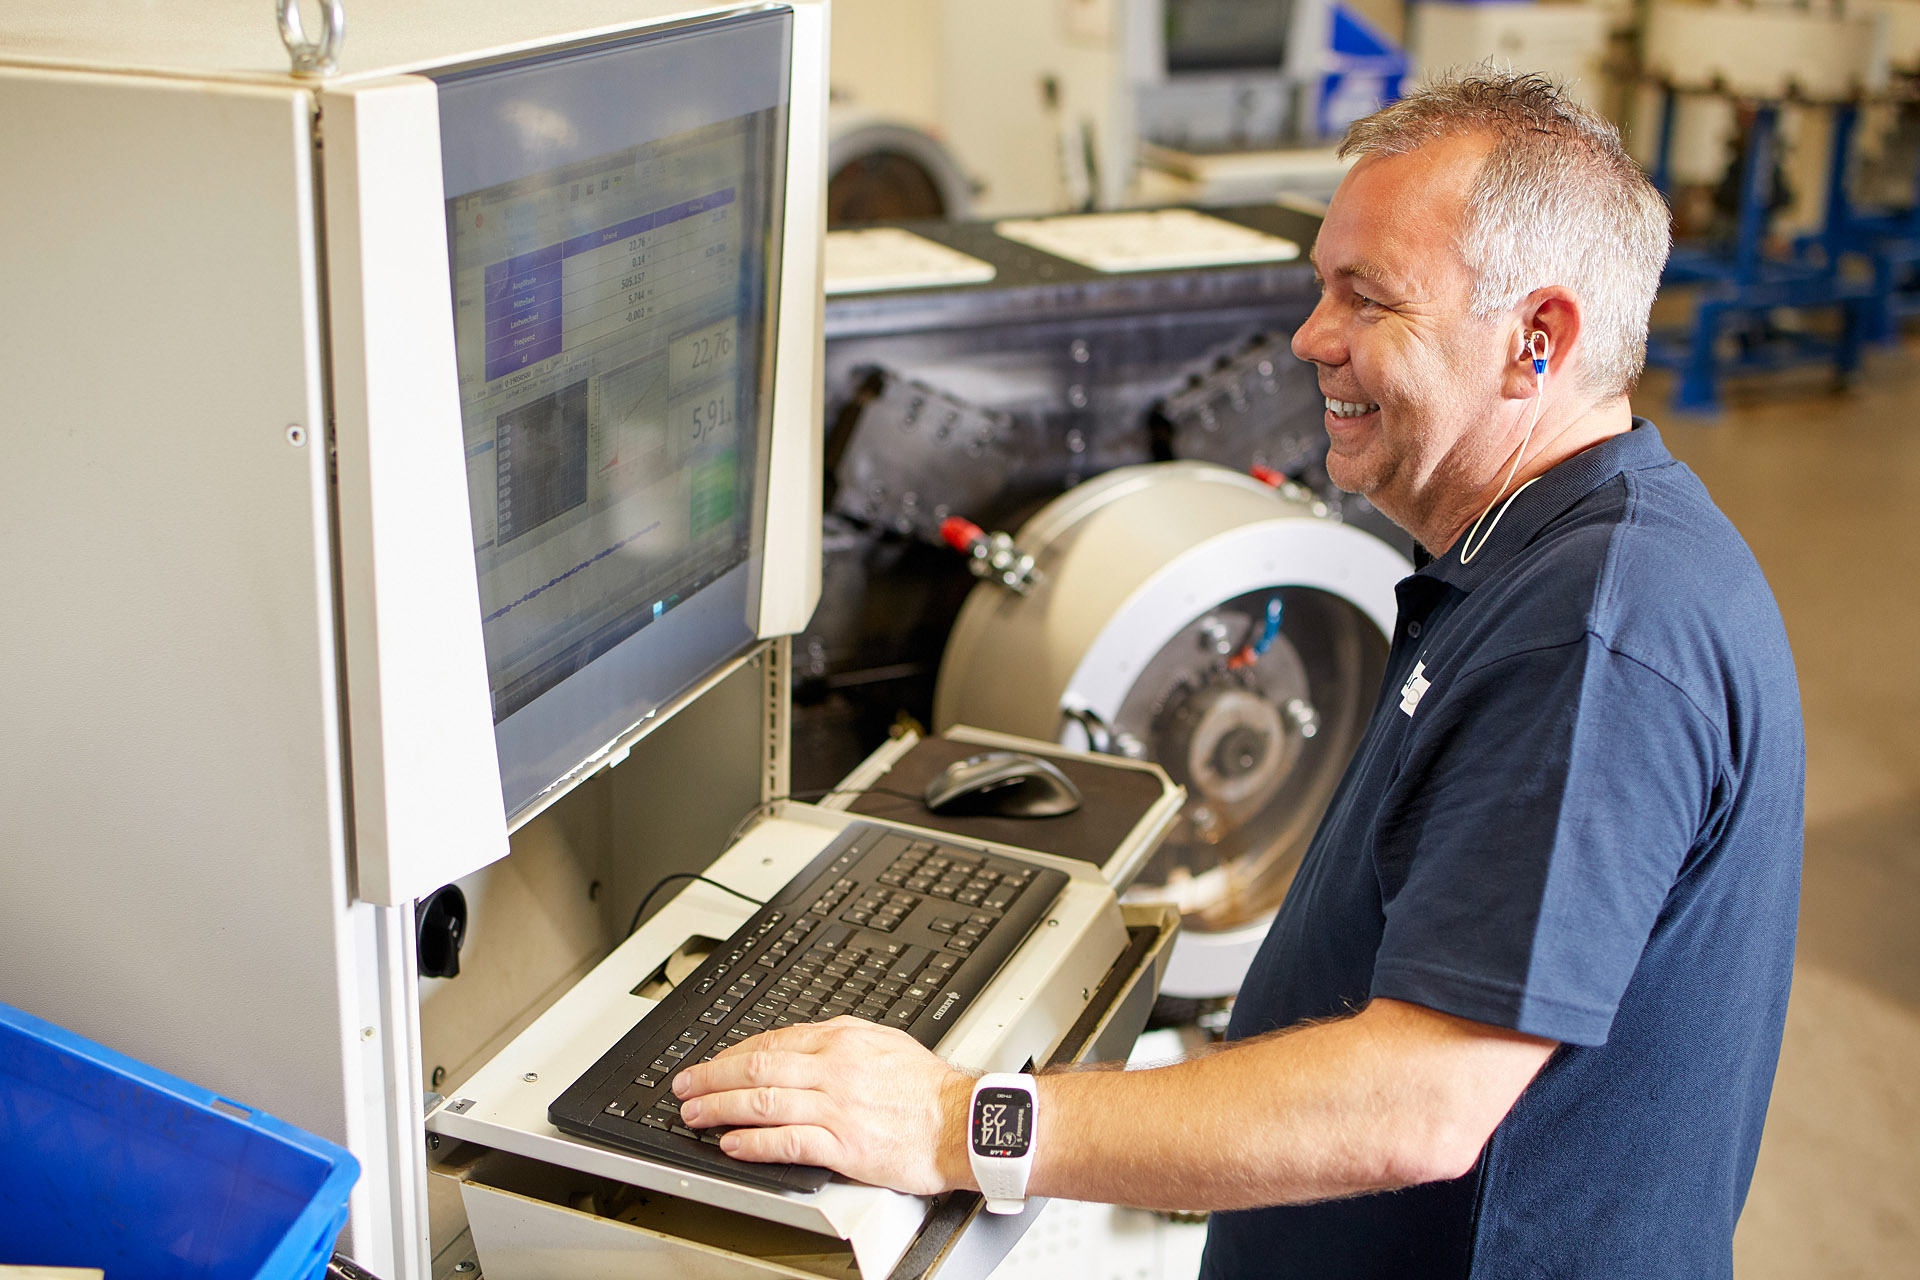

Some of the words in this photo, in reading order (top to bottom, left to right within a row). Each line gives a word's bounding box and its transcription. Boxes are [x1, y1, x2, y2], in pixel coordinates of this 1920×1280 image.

[512, 276, 537, 291] Amplitude
[513, 296, 536, 309] Mittellast
[511, 312, 539, 329] Lastwechsel
[514, 334, 536, 347] Frequenz
[692, 328, 730, 369] 22,76
[932, 998, 954, 1020] CHERRY
[982, 1104, 1007, 1127] 23
[1016, 1108, 1025, 1137] Wednesday
[981, 1127, 1004, 1146] 14
